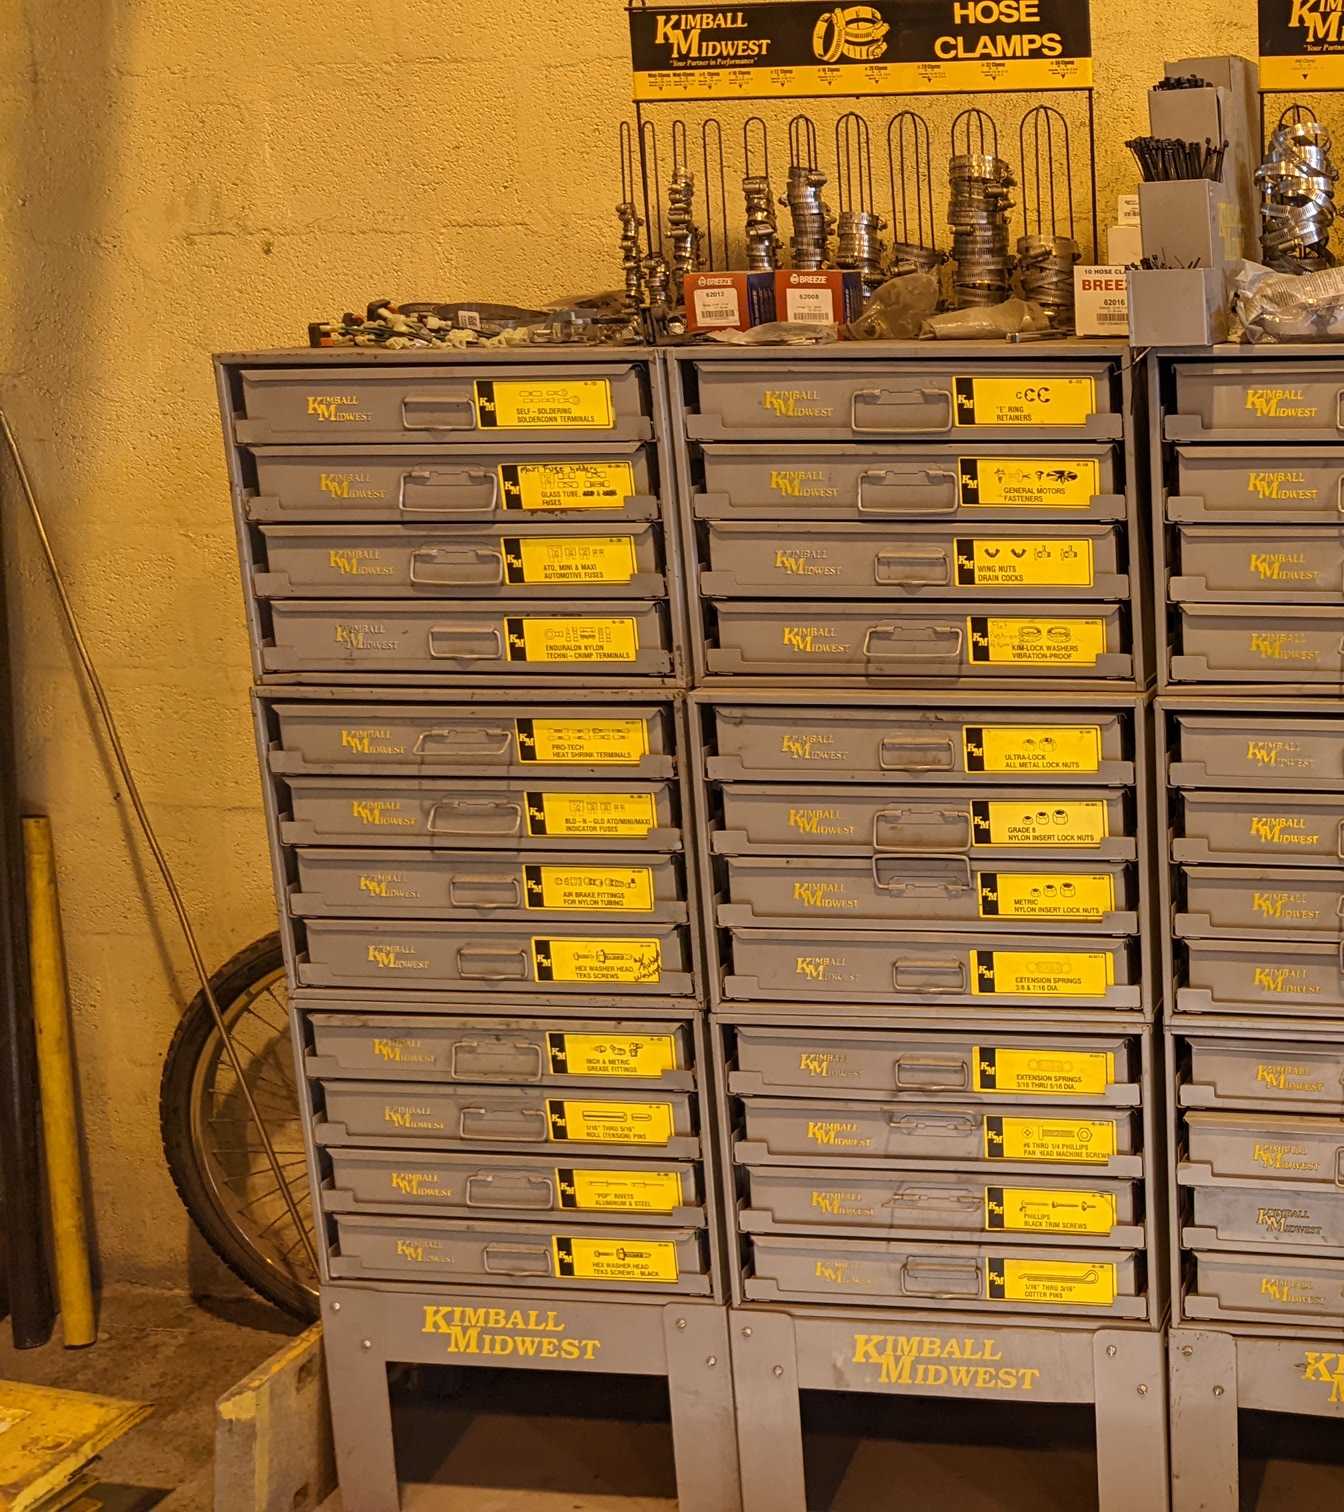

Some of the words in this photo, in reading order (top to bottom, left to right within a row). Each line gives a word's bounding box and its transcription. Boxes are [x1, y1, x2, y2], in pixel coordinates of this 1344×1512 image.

[954, 0, 1040, 24] HOSE
[655, 12, 747, 43] KIMBALL
[672, 29, 771, 58] MIDWEST
[934, 33, 1063, 59] CLAMPS
[707, 278, 733, 286] BREEZE
[800, 275, 827, 284] BREEZE
[1082, 279, 1129, 291] BREE
[1104, 298, 1125, 306] 62016
[306, 396, 358, 415] KIMBALL
[764, 390, 820, 409] KIMBALL
[775, 400, 833, 417] MIDWEST
[1246, 390, 1303, 409] KIMBALL
[1256, 399, 1317, 417] MIDWEST
[318, 404, 372, 422] MIDWEST
[1248, 472, 1304, 491] KIMBALL
[1259, 481, 1318, 500] MIDWEST
[422, 1305, 565, 1334] KIMBALL
[447, 1327, 601, 1360] MIDWEST
[854, 1334, 1001, 1362] KIMBALL
[879, 1357, 1039, 1388] MIDWEST
